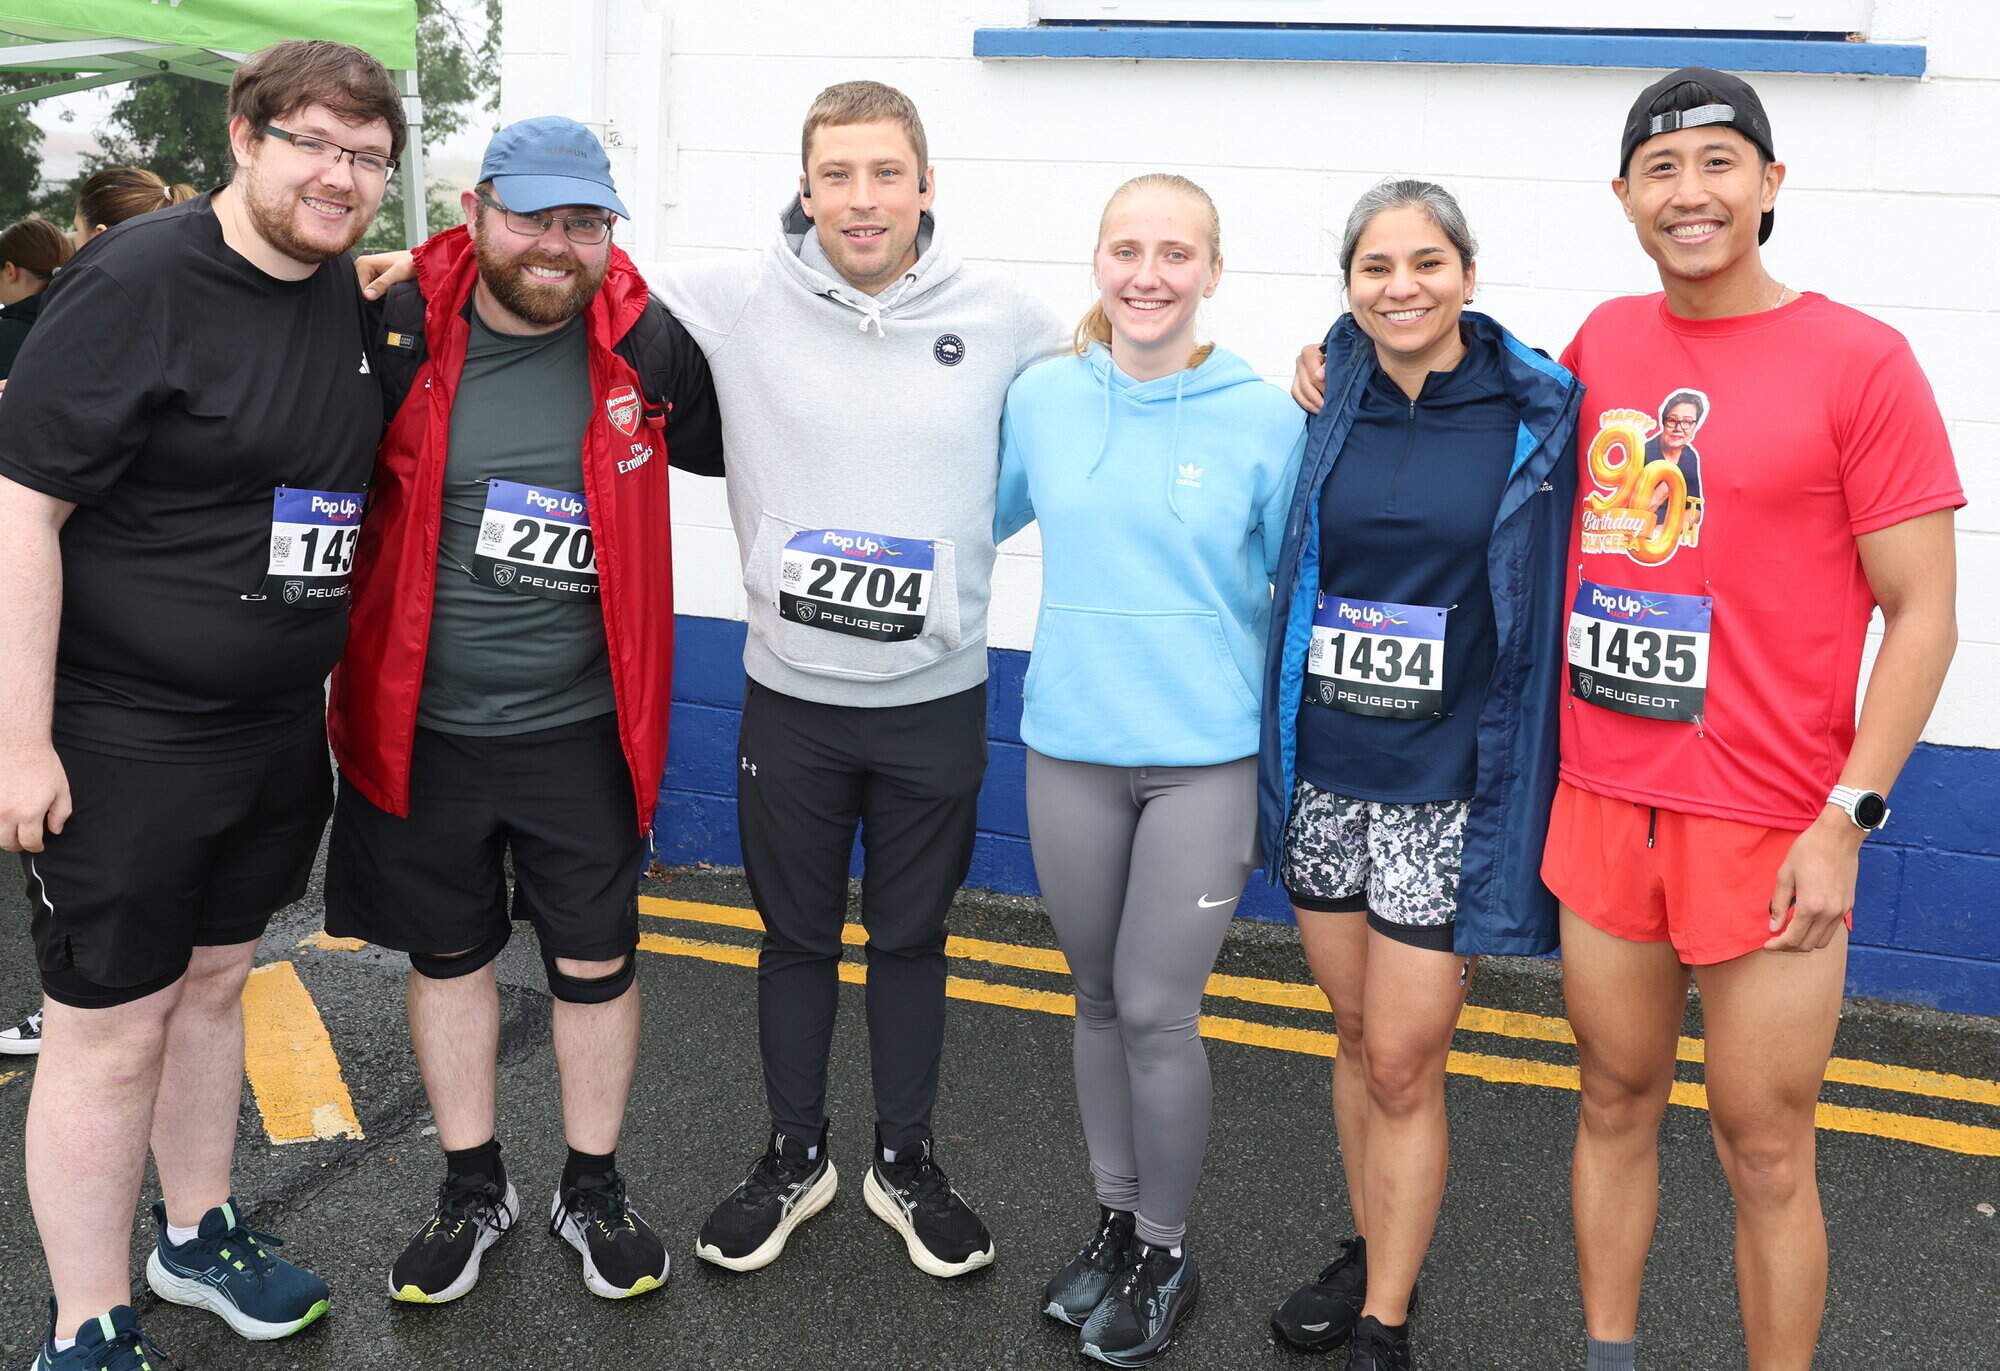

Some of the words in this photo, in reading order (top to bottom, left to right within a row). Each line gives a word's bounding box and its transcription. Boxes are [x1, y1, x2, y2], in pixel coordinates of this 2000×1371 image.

[608, 390, 636, 408] Arsenal
[311, 496, 339, 518] Pop
[340, 499, 357, 519] Up
[526, 490, 559, 512] Pop
[560, 496, 583, 517] Up
[1588, 425, 1688, 566] 90
[1582, 510, 1646, 538] Birthday
[301, 528, 358, 572] 143
[507, 519, 599, 572] 270
[822, 531, 853, 553] Pop
[855, 535, 880, 557] Up
[519, 575, 600, 594] PEUGEOT
[806, 558, 923, 612] 2704
[1338, 602, 1361, 625] Pop
[1362, 606, 1384, 627] Up
[1592, 588, 1617, 613] Pop
[1618, 594, 1641, 617] Up
[820, 612, 905, 633] PEUGEOT
[1330, 632, 1435, 686] 1434
[1587, 621, 1697, 683] 1435
[1337, 691, 1420, 710] PEUGEOT
[1595, 684, 1681, 710] PEUGEOT
